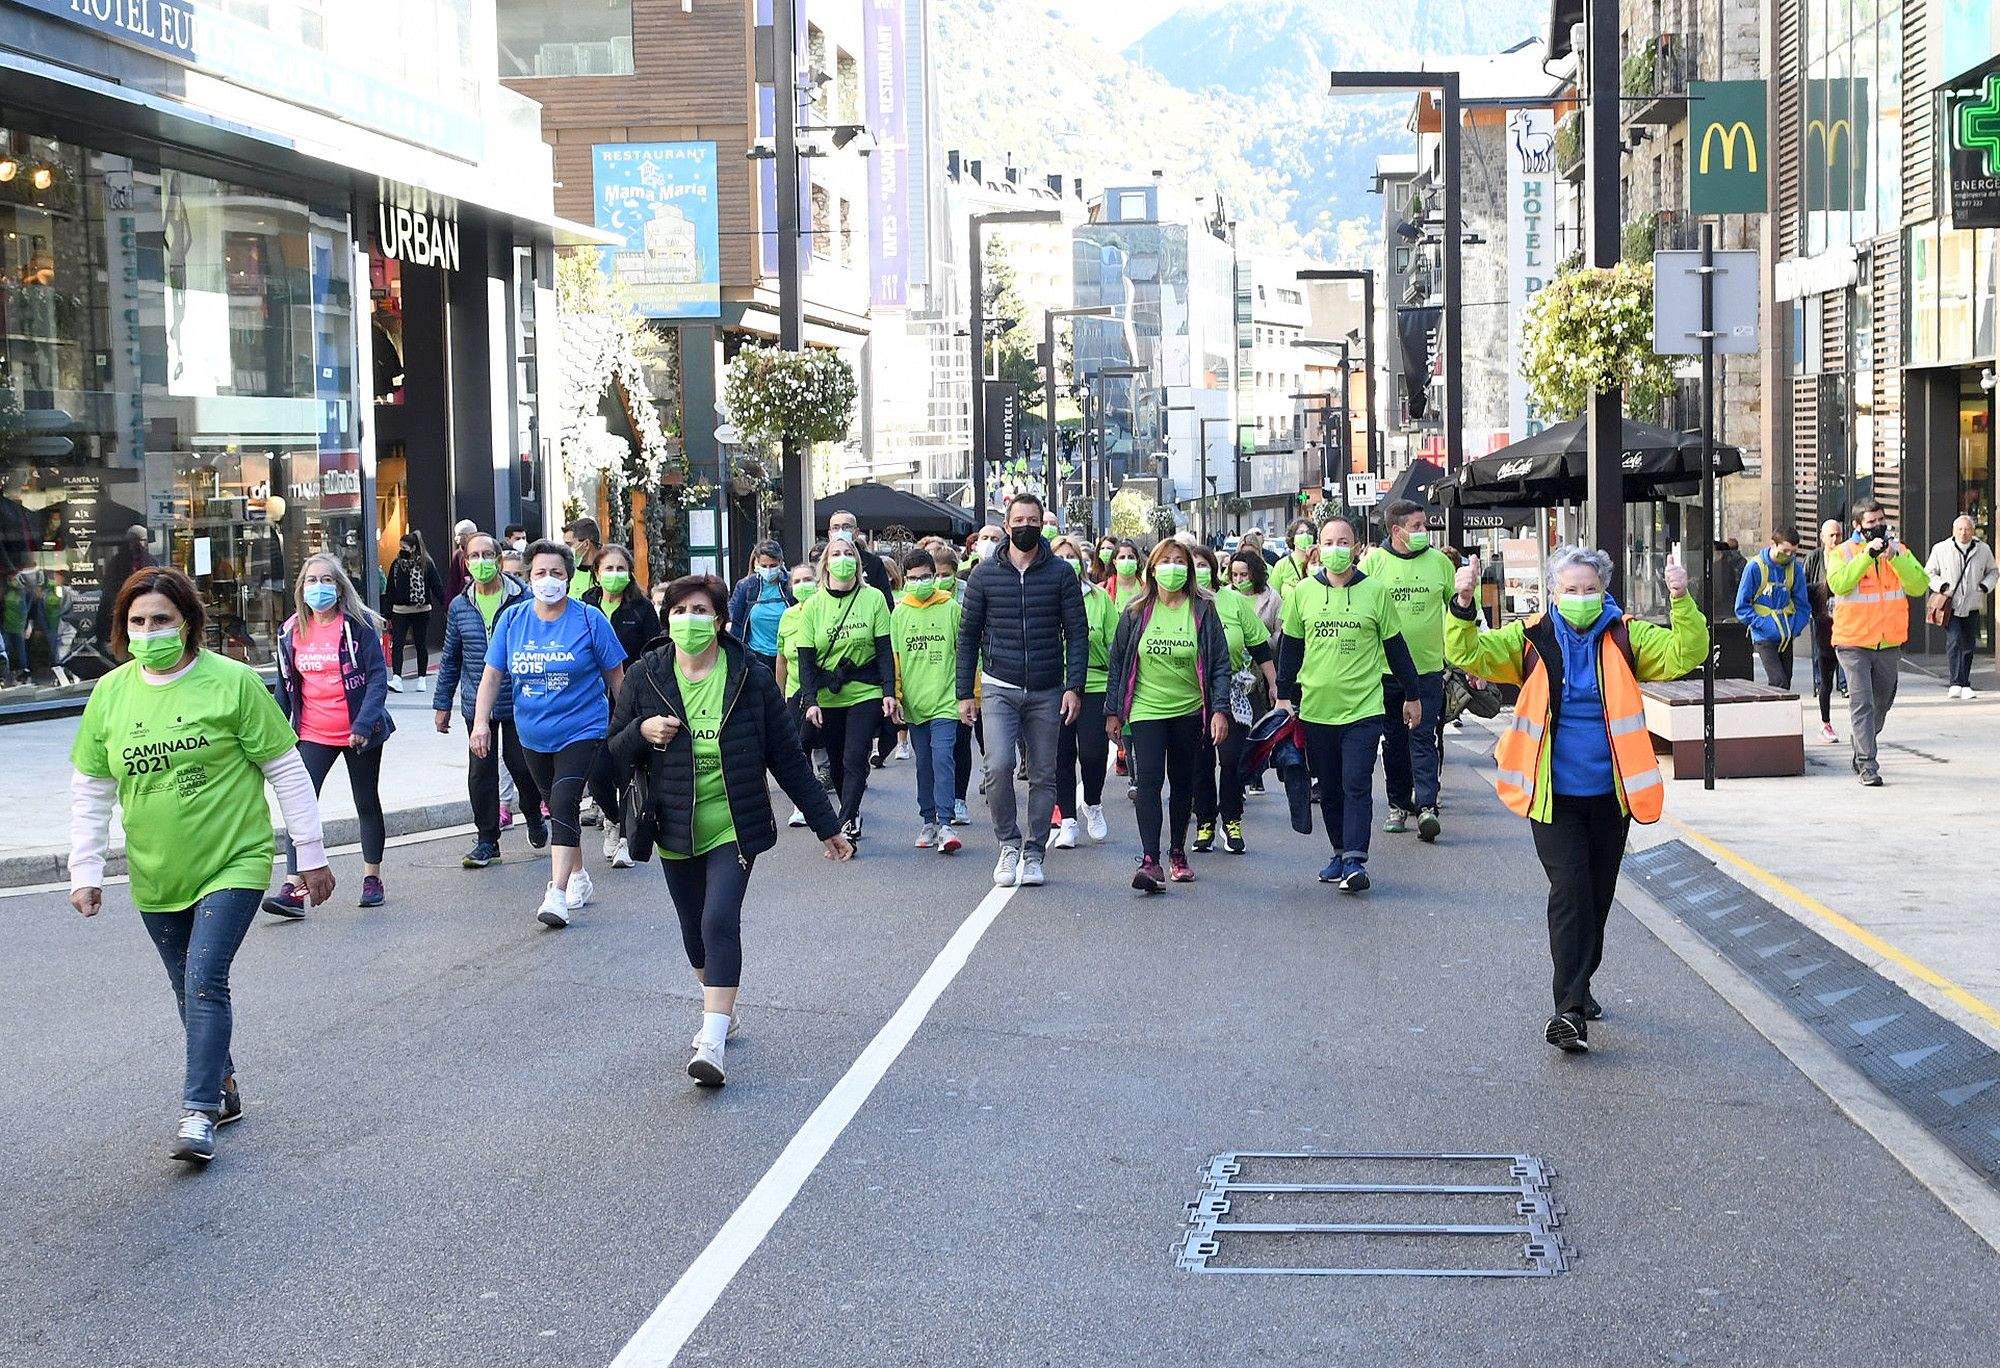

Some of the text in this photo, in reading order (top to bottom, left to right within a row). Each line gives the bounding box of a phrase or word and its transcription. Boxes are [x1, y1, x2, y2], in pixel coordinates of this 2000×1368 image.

[602, 148, 707, 161] RESTAURANT
[604, 183, 708, 202] Mama Maria
[1523, 180, 1542, 267] HOTEL
[379, 202, 460, 272] URBAN
[1004, 395, 1014, 458] MERITXELL
[1356, 482, 1367, 496] H
[1388, 586, 1430, 594] CAMINADA
[1314, 620, 1362, 629] CAMINADA
[905, 634, 947, 645] CAMINADA
[1315, 628, 1339, 638] 2021
[906, 641, 928, 652] 2021
[1146, 638, 1195, 648] CAMINADA
[512, 651, 576, 662] CAMINADA
[1146, 645, 1172, 656] 2021
[511, 661, 544, 675] 2015
[122, 735, 211, 760] CAMINADA
[124, 755, 171, 777] 2021
